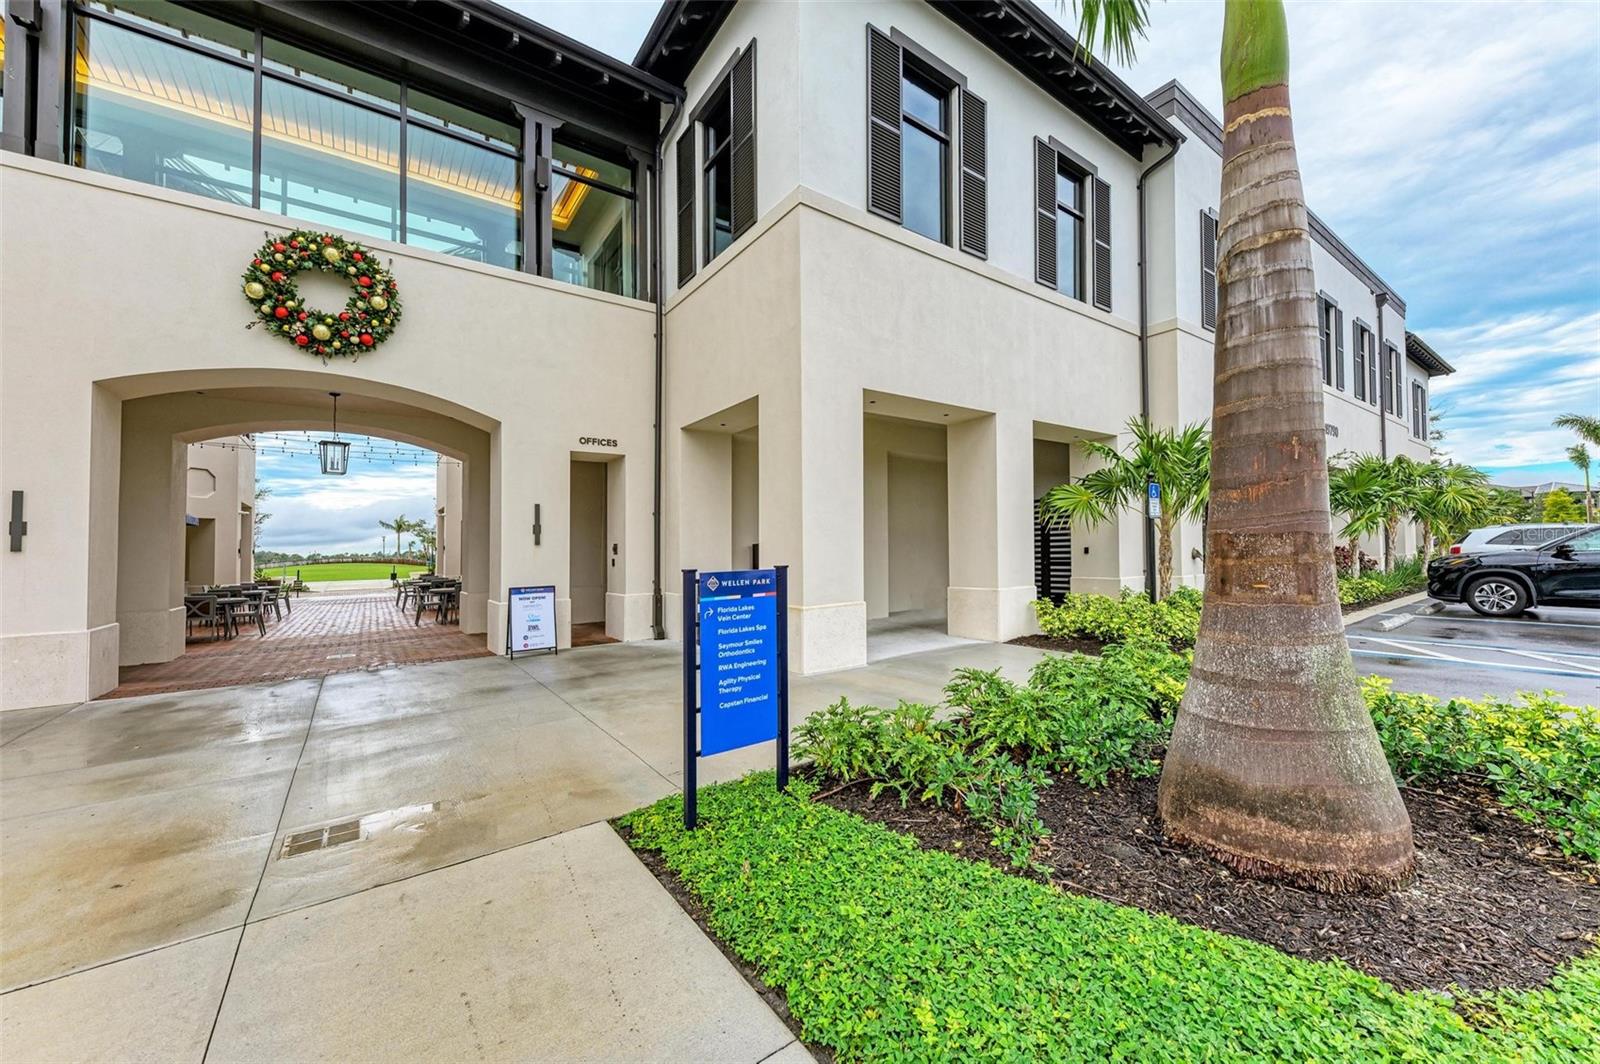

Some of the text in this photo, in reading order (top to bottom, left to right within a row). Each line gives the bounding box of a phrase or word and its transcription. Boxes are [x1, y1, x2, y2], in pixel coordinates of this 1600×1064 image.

[579, 436, 618, 447] OFFICES
[721, 579, 750, 587] WELLEN
[718, 627, 738, 635] Florida
[755, 624, 767, 632] Spa
[718, 642, 744, 650] Seymour
[718, 648, 755, 658] Orthodontics
[718, 659, 767, 671] RWA Engineering
[719, 673, 761, 686] Agility Physical
[719, 686, 742, 694] Therapy
[719, 693, 769, 709] Capstan Financial
